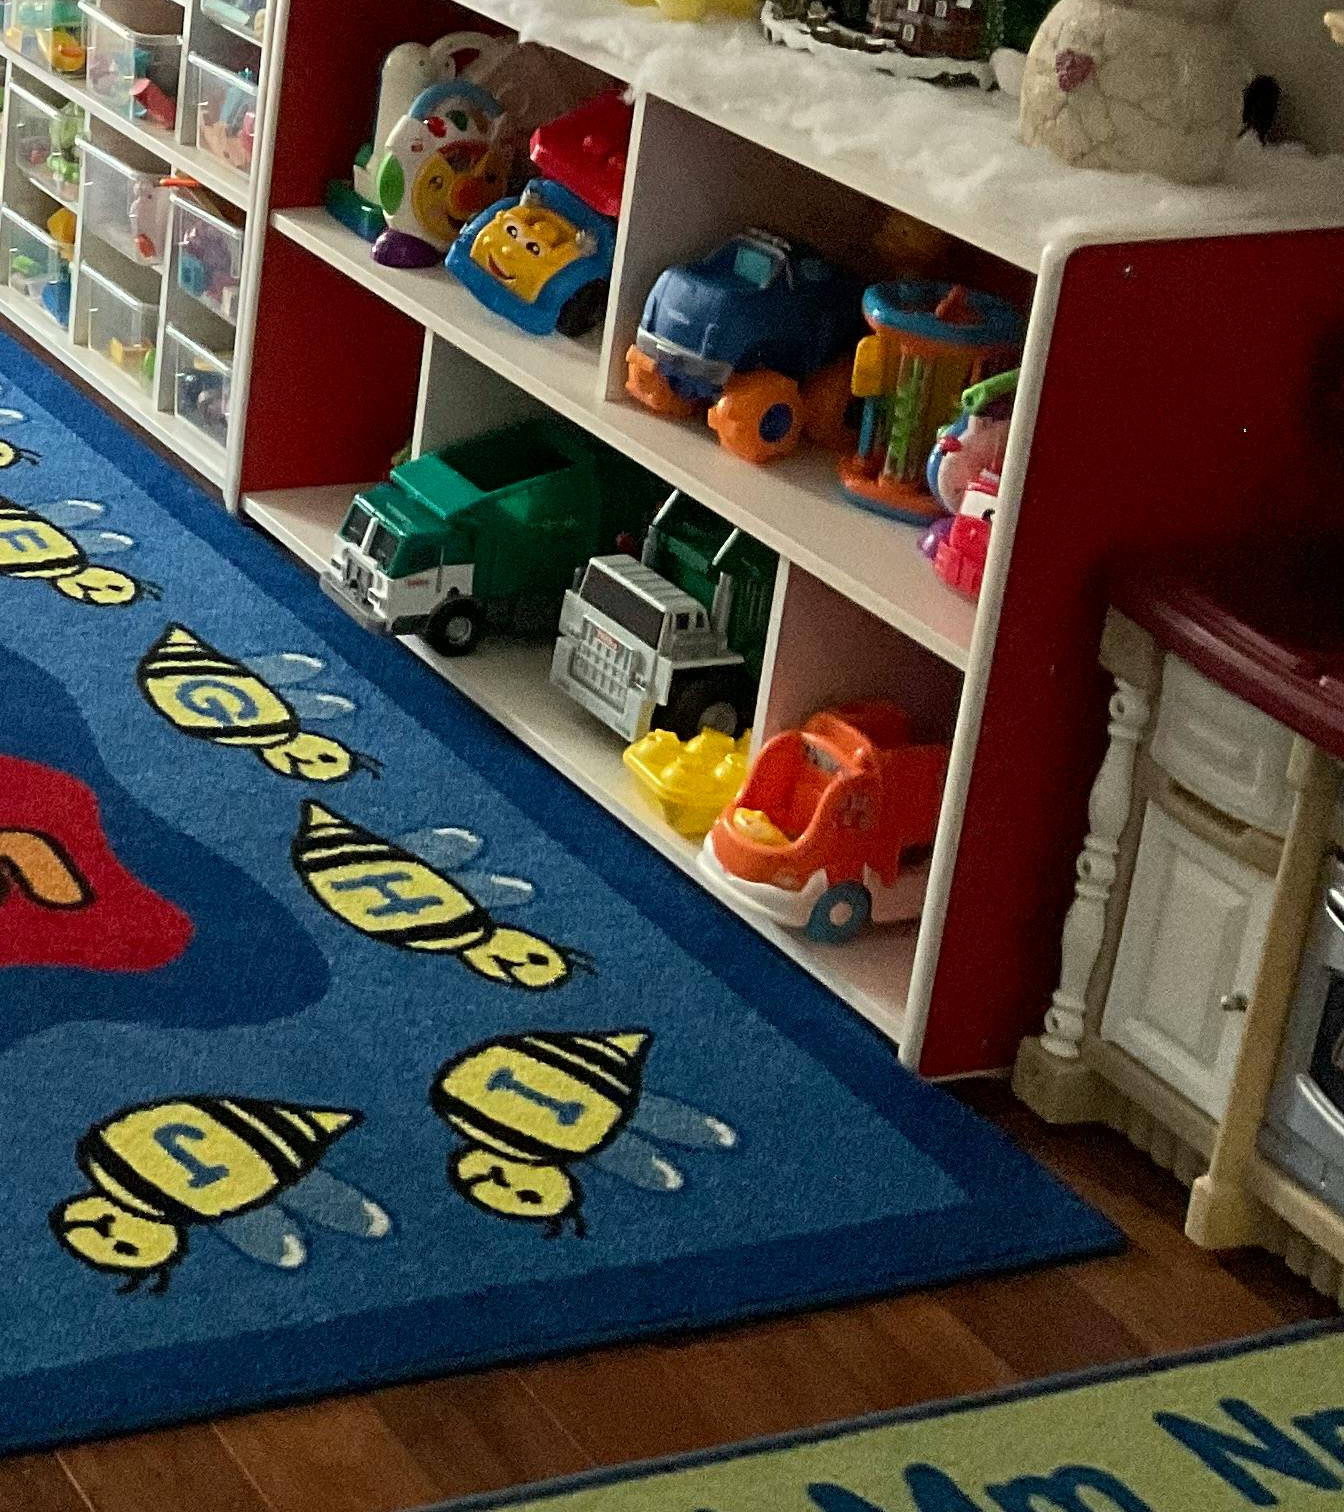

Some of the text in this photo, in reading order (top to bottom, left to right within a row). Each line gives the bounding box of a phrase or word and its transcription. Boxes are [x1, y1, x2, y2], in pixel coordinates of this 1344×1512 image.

[175, 679, 259, 724] G
[330, 871, 444, 917] H
[487, 1068, 585, 1126] I
[153, 1123, 230, 1188] J
